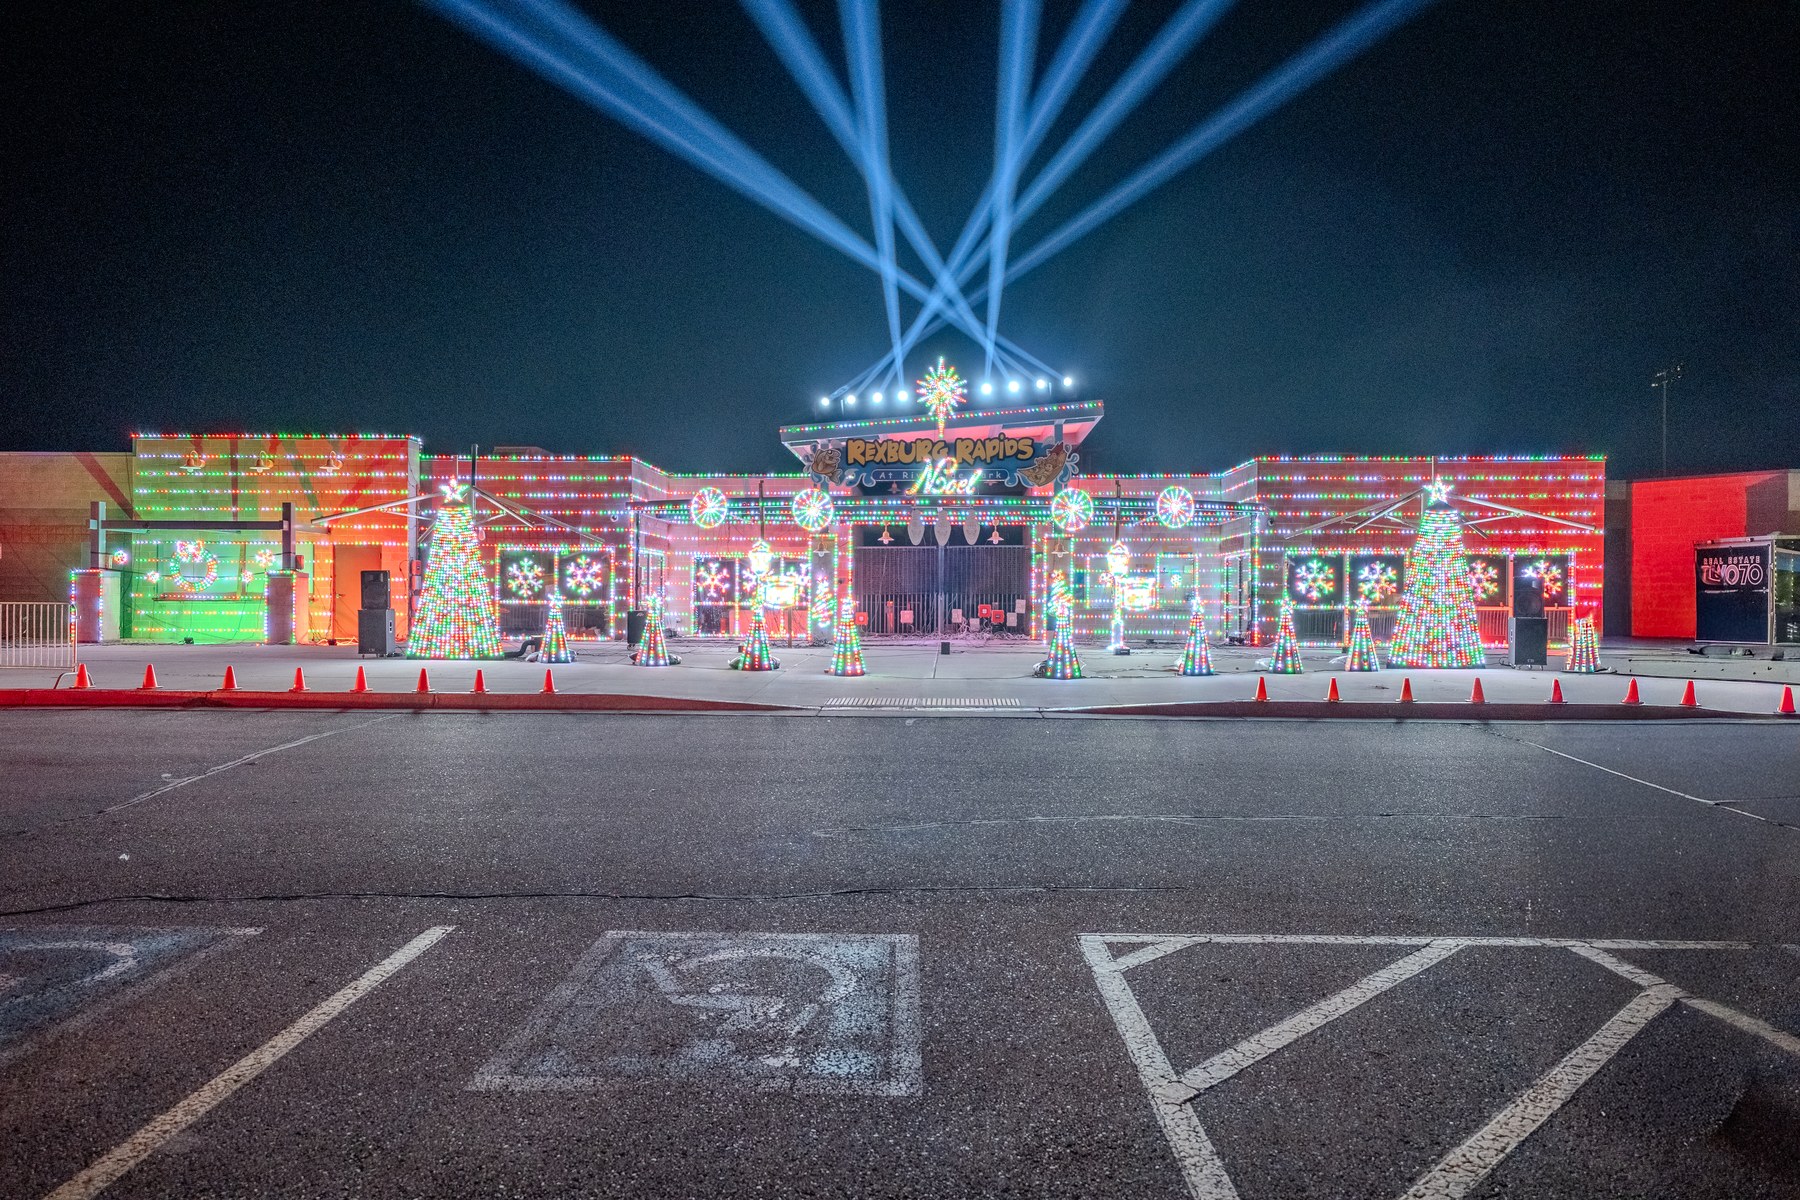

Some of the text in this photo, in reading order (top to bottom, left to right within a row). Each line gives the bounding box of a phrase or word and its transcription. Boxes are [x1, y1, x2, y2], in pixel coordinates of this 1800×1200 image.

[847, 438, 949, 466] REXBURG
[879, 472, 894, 481] At
[974, 472, 1003, 481] ark
[1703, 555, 1760, 565] REAL ESTATE
